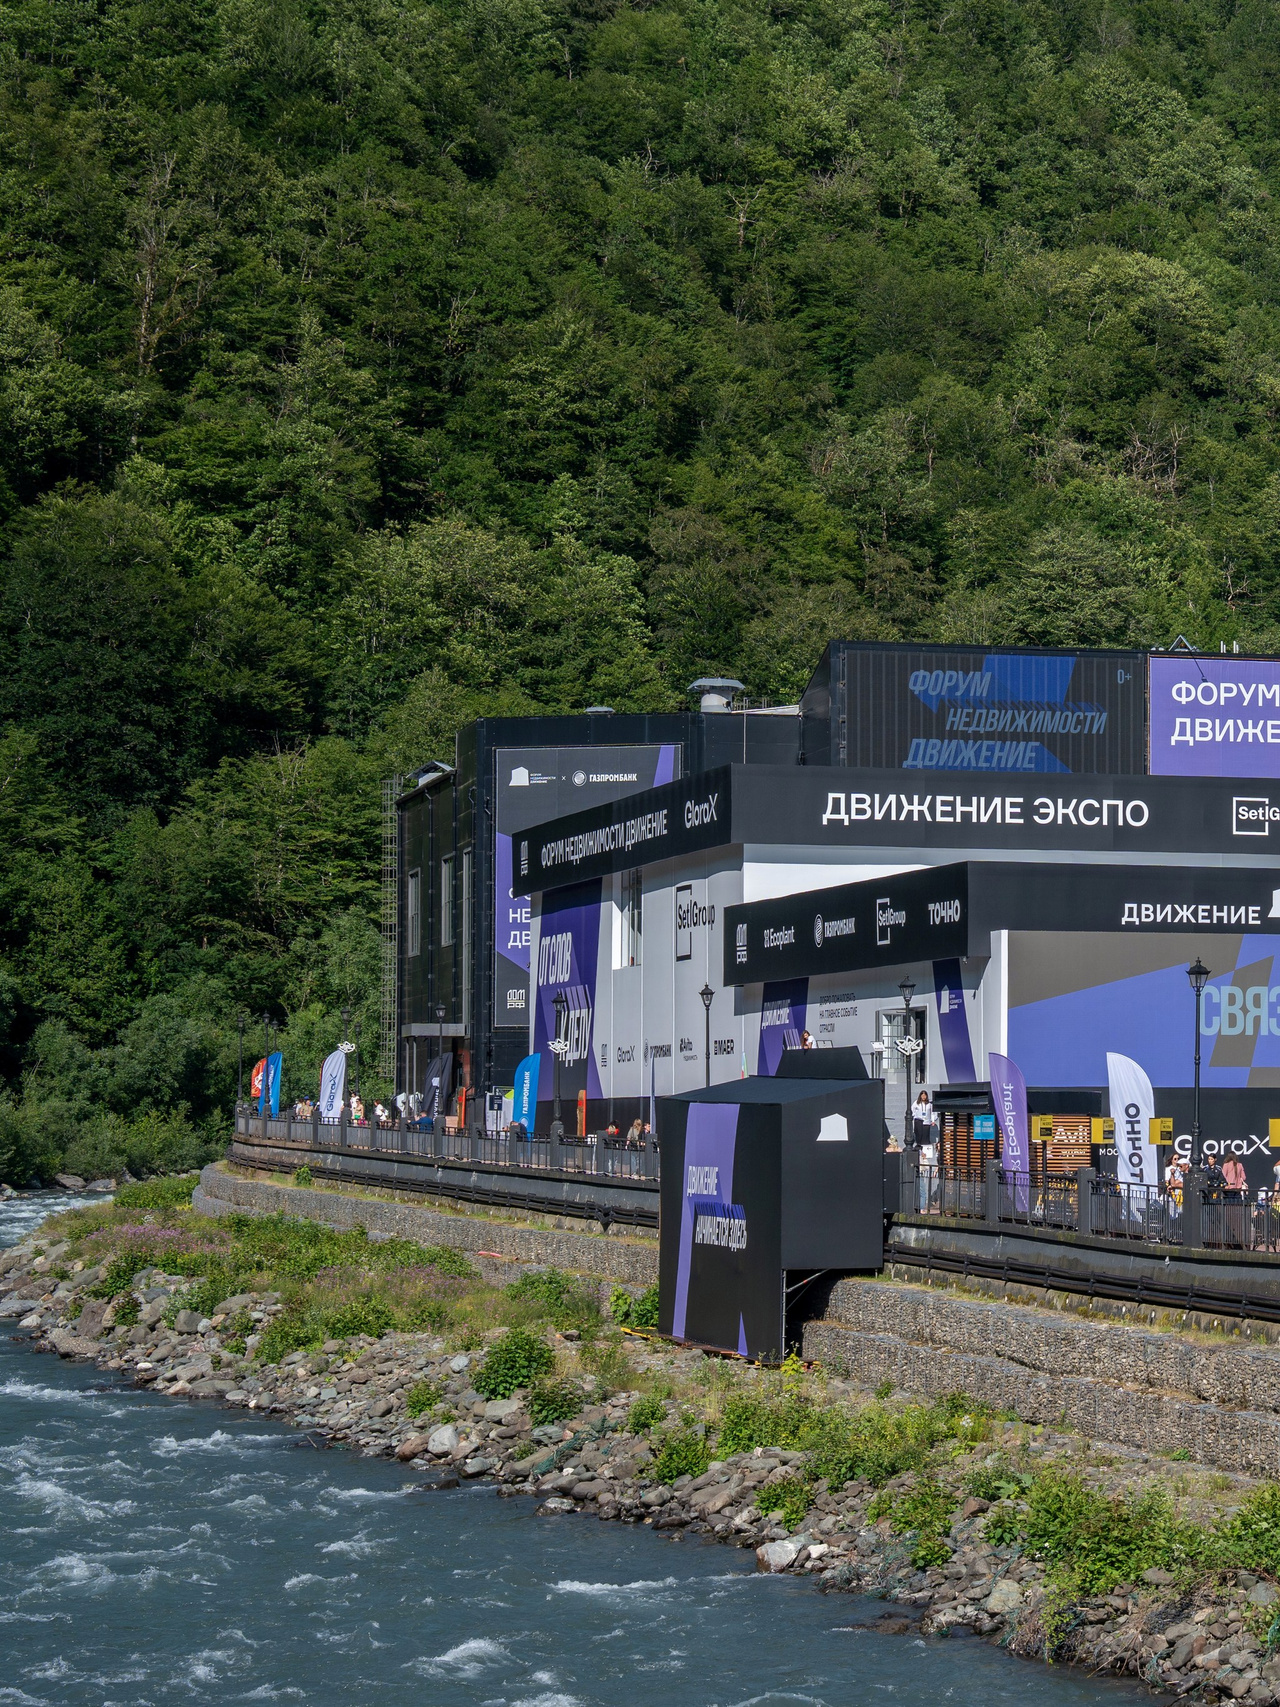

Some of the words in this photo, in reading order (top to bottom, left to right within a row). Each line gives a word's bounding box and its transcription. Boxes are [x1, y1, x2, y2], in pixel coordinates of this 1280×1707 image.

[908, 670, 992, 697] ФОРУМ
[1117, 669, 1132, 684] 0+
[1171, 680, 1280, 707] ФОРУМ
[945, 708, 1107, 734] НЕДВИЖИМОСТИ
[903, 738, 1040, 769] ДВИЖЕНИЕ
[589, 773, 637, 782] ГАЗПРОМБАНК
[684, 793, 718, 828] GloraX
[822, 792, 1024, 826] ДВИЖЕНИЕ
[1033, 797, 1150, 827] ЭКСПО
[541, 843, 565, 868] ФОРУМ
[565, 823, 625, 865] НЕДВИЖИМОСТИ
[625, 809, 668, 851] ДВИЖЕНИЕ
[928, 899, 961, 925] ТОЧНО
[1121, 903, 1261, 925] ДВИЖЕНИЕ
[770, 926, 795, 950] Ecoplant
[824, 917, 856, 938] ГАЗПРОМБАНК
[326, 1073, 338, 1112] GloraX
[522, 1071, 531, 1114] ГАЗПРОМБАНК
[1174, 1135, 1272, 1156] GoraX
[687, 1165, 718, 1197] ДВИЖЕНИЕ
[695, 1215, 729, 1247] НАЧИНАЕТСЯ
[729, 1219, 747, 1252] ЗДЕСЬ
